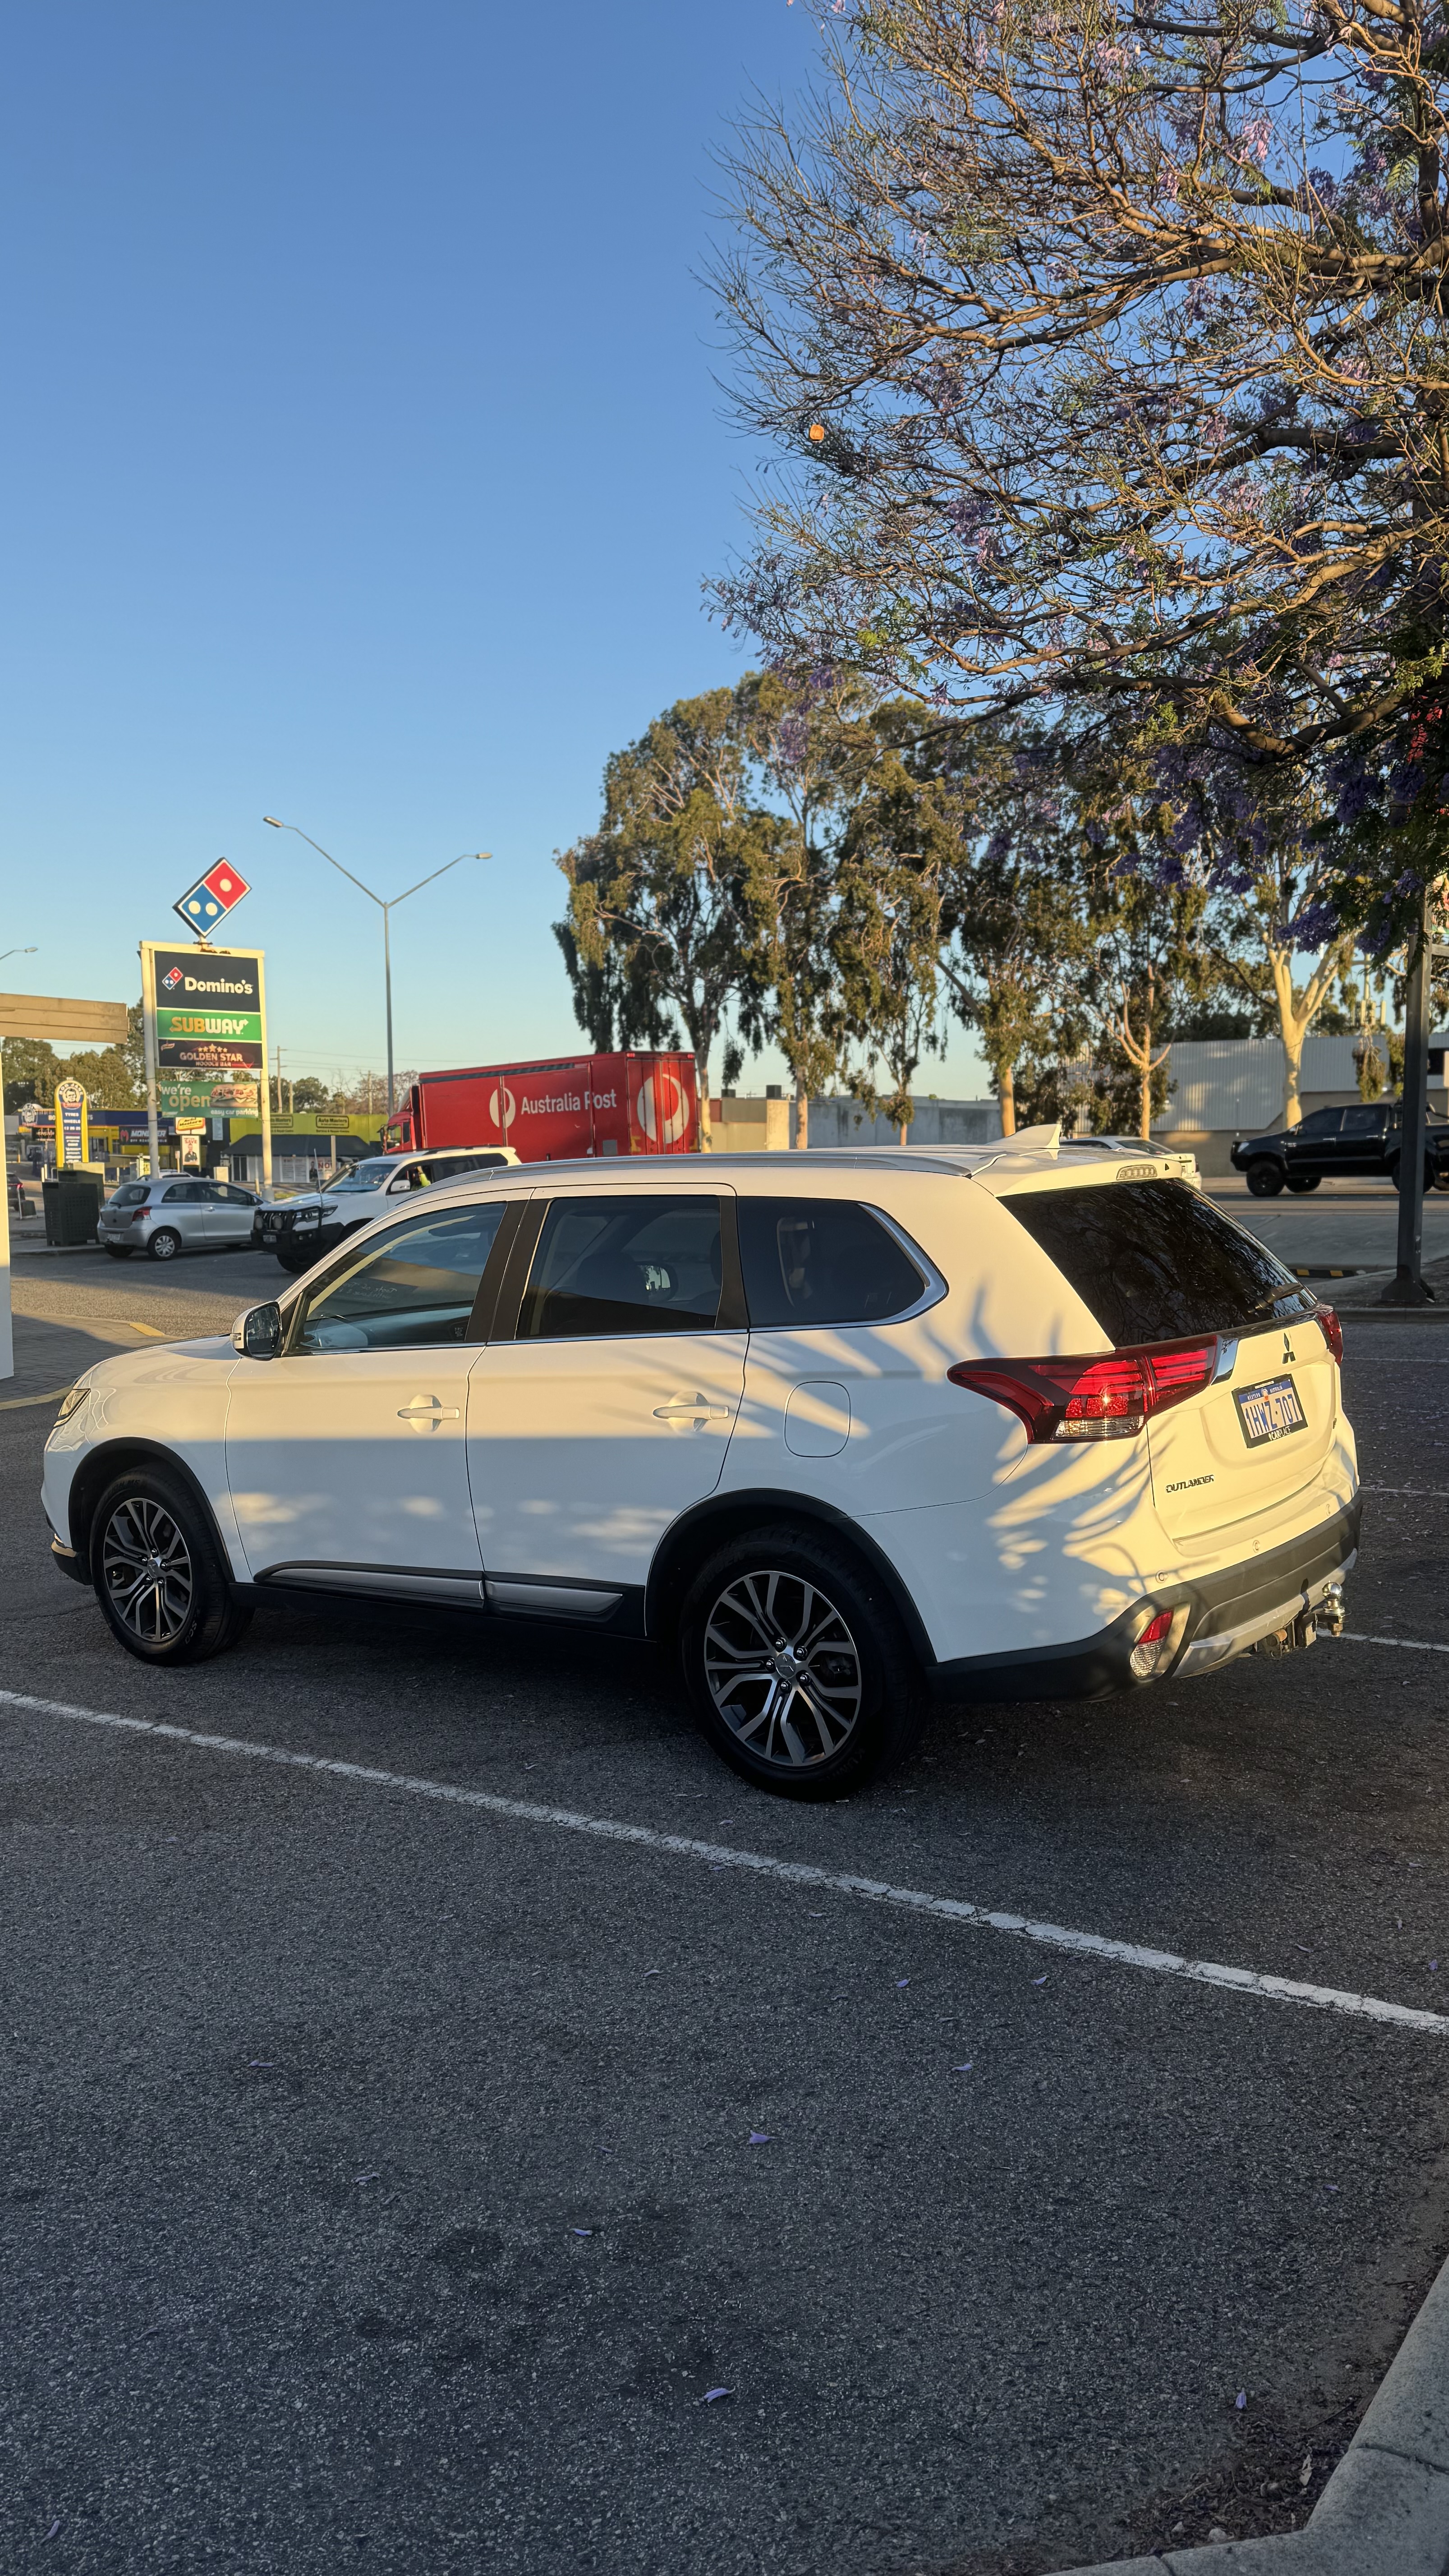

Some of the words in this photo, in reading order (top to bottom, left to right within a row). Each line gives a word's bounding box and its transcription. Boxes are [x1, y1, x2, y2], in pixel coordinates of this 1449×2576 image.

[184, 977, 253, 994] Domino's
[170, 1017, 248, 1035] SUBWAY
[180, 1052, 217, 1061] GOLDEN
[220, 1053, 243, 1062] STAR
[161, 1084, 192, 1095] we're
[169, 1095, 210, 1111] open
[521, 1092, 580, 1115] Australia
[584, 1089, 616, 1109] Post
[1165, 1474, 1214, 1493] OUTLANDER
